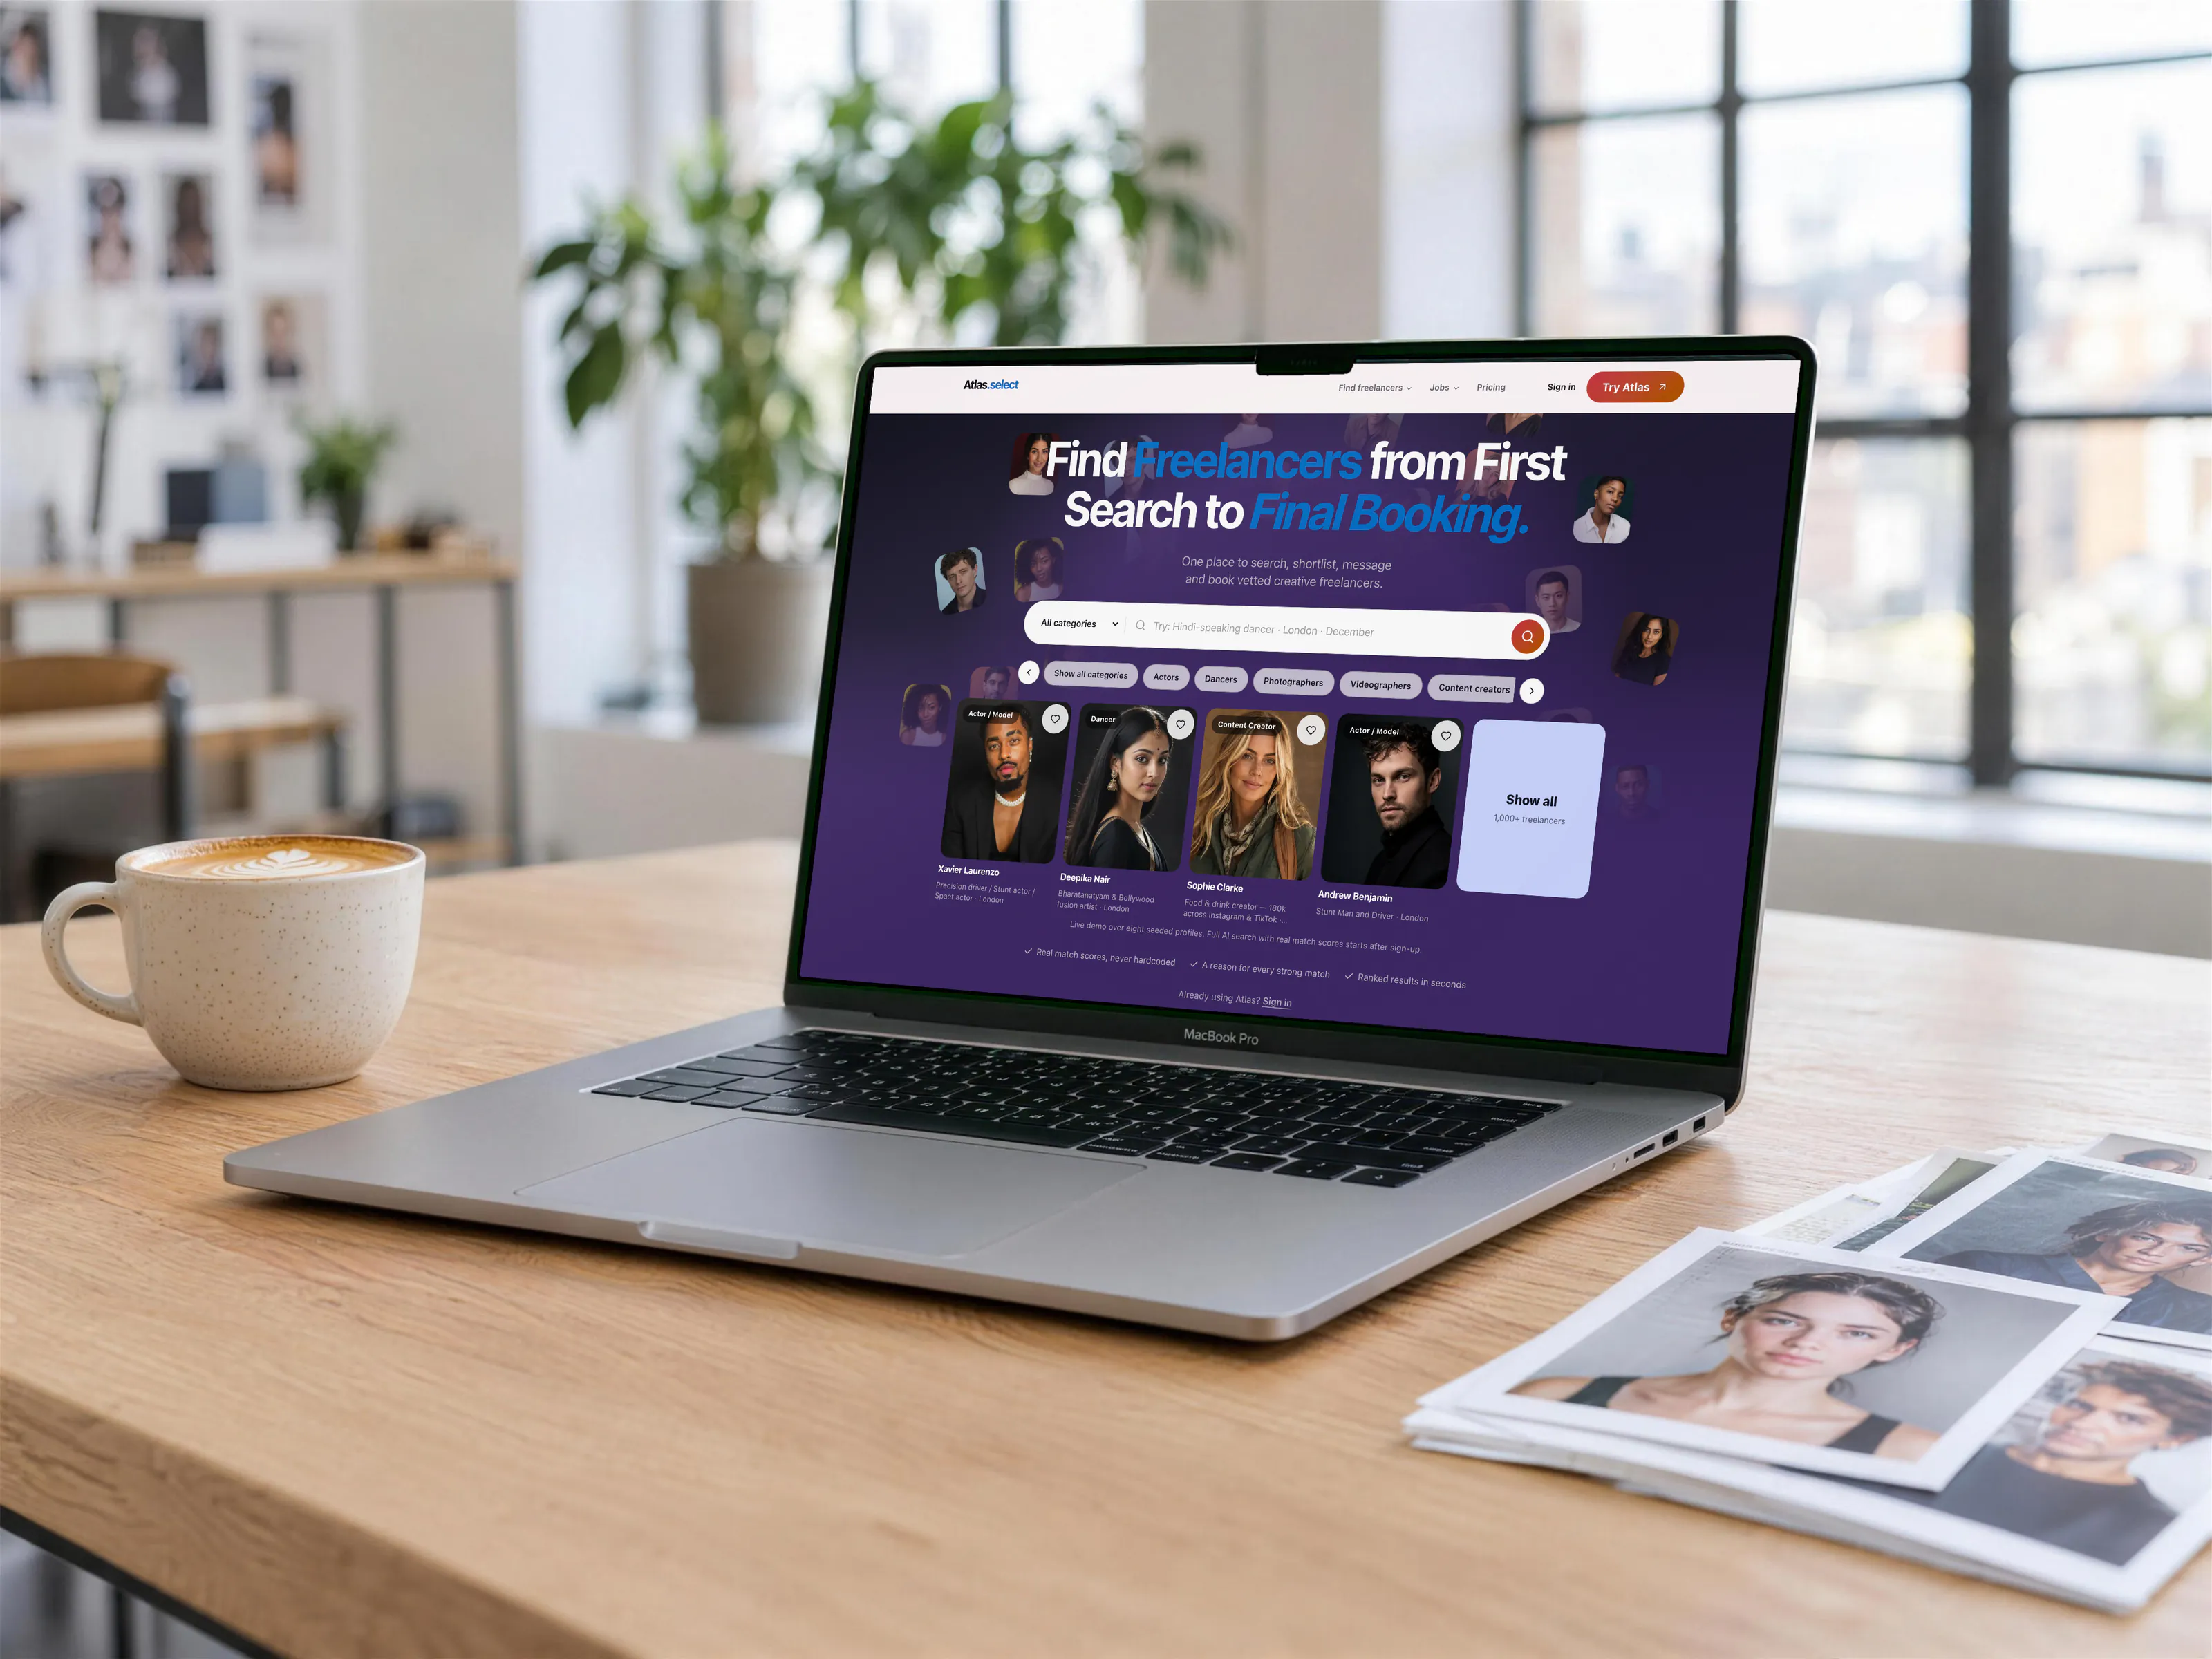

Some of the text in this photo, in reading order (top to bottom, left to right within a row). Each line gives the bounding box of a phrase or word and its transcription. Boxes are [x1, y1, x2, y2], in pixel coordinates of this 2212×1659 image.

[963, 379, 1019, 390] Atlas.select
[1338, 384, 1403, 392] Find freelancers
[1477, 383, 1506, 393] Pricing
[1547, 383, 1566, 393] Sign
[1602, 382, 1650, 394] Try Atlas
[1047, 440, 1568, 481] Find Freelancers from First
[1065, 490, 1528, 544] Search to Final Booking.
[1182, 556, 1392, 573] One place to search, shortlist, message
[1185, 574, 1382, 588] and book vetted creative freelancers.
[1040, 618, 1096, 629] All categories
[1154, 621, 1170, 632] Try:
[1172, 621, 1241, 635] Hindi-speaking
[1243, 624, 1275, 634] dancer
[1283, 625, 1318, 635] London
[1325, 626, 1375, 637] December
[1054, 669, 1128, 680] Show all categories
[1153, 673, 1179, 682] Actors
[1205, 675, 1237, 684] Dancers
[1264, 677, 1324, 688] Photographers
[1351, 679, 1412, 691] Videographers
[1438, 683, 1510, 694] Content creators
[988, 711, 992, 719] /
[1248, 722, 1276, 730] Creator
[1371, 727, 1376, 735] /
[1376, 727, 1400, 735] Model
[1506, 794, 1557, 807] Show all
[1494, 814, 1566, 825] 1,000+ freelancers
[937, 865, 1000, 877] Xavier Laurenzo
[1060, 872, 1111, 883] Deepika Nair
[935, 881, 966, 892] Precision
[968, 883, 988, 892] driver
[988, 885, 993, 893] /
[993, 885, 1012, 894] Stunt
[1032, 888, 1036, 896] /
[1186, 881, 1244, 893] Sophie Clarke
[935, 892, 955, 901] Spact
[978, 895, 1004, 903] London
[1058, 890, 1110, 902] Bharatanatyam
[1118, 894, 1155, 903] Bollywood
[1318, 890, 1393, 903] Andrew Benjamin
[1057, 900, 1078, 909] fusion
[1079, 902, 1098, 910] artist
[1103, 903, 1130, 912] London
[1184, 898, 1203, 907] Food
[1204, 899, 1210, 908] &
[1212, 900, 1230, 908] drink
[1268, 904, 1286, 912] 180k
[1208, 911, 1244, 921] Instagram
[1254, 914, 1277, 924] TikTok
[1315, 907, 1336, 916] Stunt
[1338, 909, 1353, 917] Man
[1371, 911, 1394, 920] Driver
[1400, 913, 1429, 922] London
[1069, 920, 1085, 928] Live
[1086, 921, 1107, 930] demo
[1125, 924, 1145, 934] eight
[1146, 927, 1174, 935] seeded
[1174, 928, 1205, 937] profiles.
[1207, 930, 1220, 939] Full
[1221, 931, 1230, 939] AI
[1231, 933, 1257, 941] search
[1258, 934, 1275, 943] with
[1292, 937, 1316, 946] match
[1345, 941, 1368, 950] starts
[1369, 942, 1389, 950] after
[1390, 944, 1422, 955] sign-up.
[1036, 948, 1053, 957] Real
[1054, 950, 1078, 959] match
[1080, 953, 1107, 962] scores,
[1134, 955, 1176, 966] hardcoded
[1201, 961, 1330, 978] A reason for every strong match
[1358, 973, 1466, 989] Ranked results in seconds
[1178, 990, 1292, 1008] Already using Atlas? Sign in
[1183, 1028, 1259, 1046] MacBook Pro
